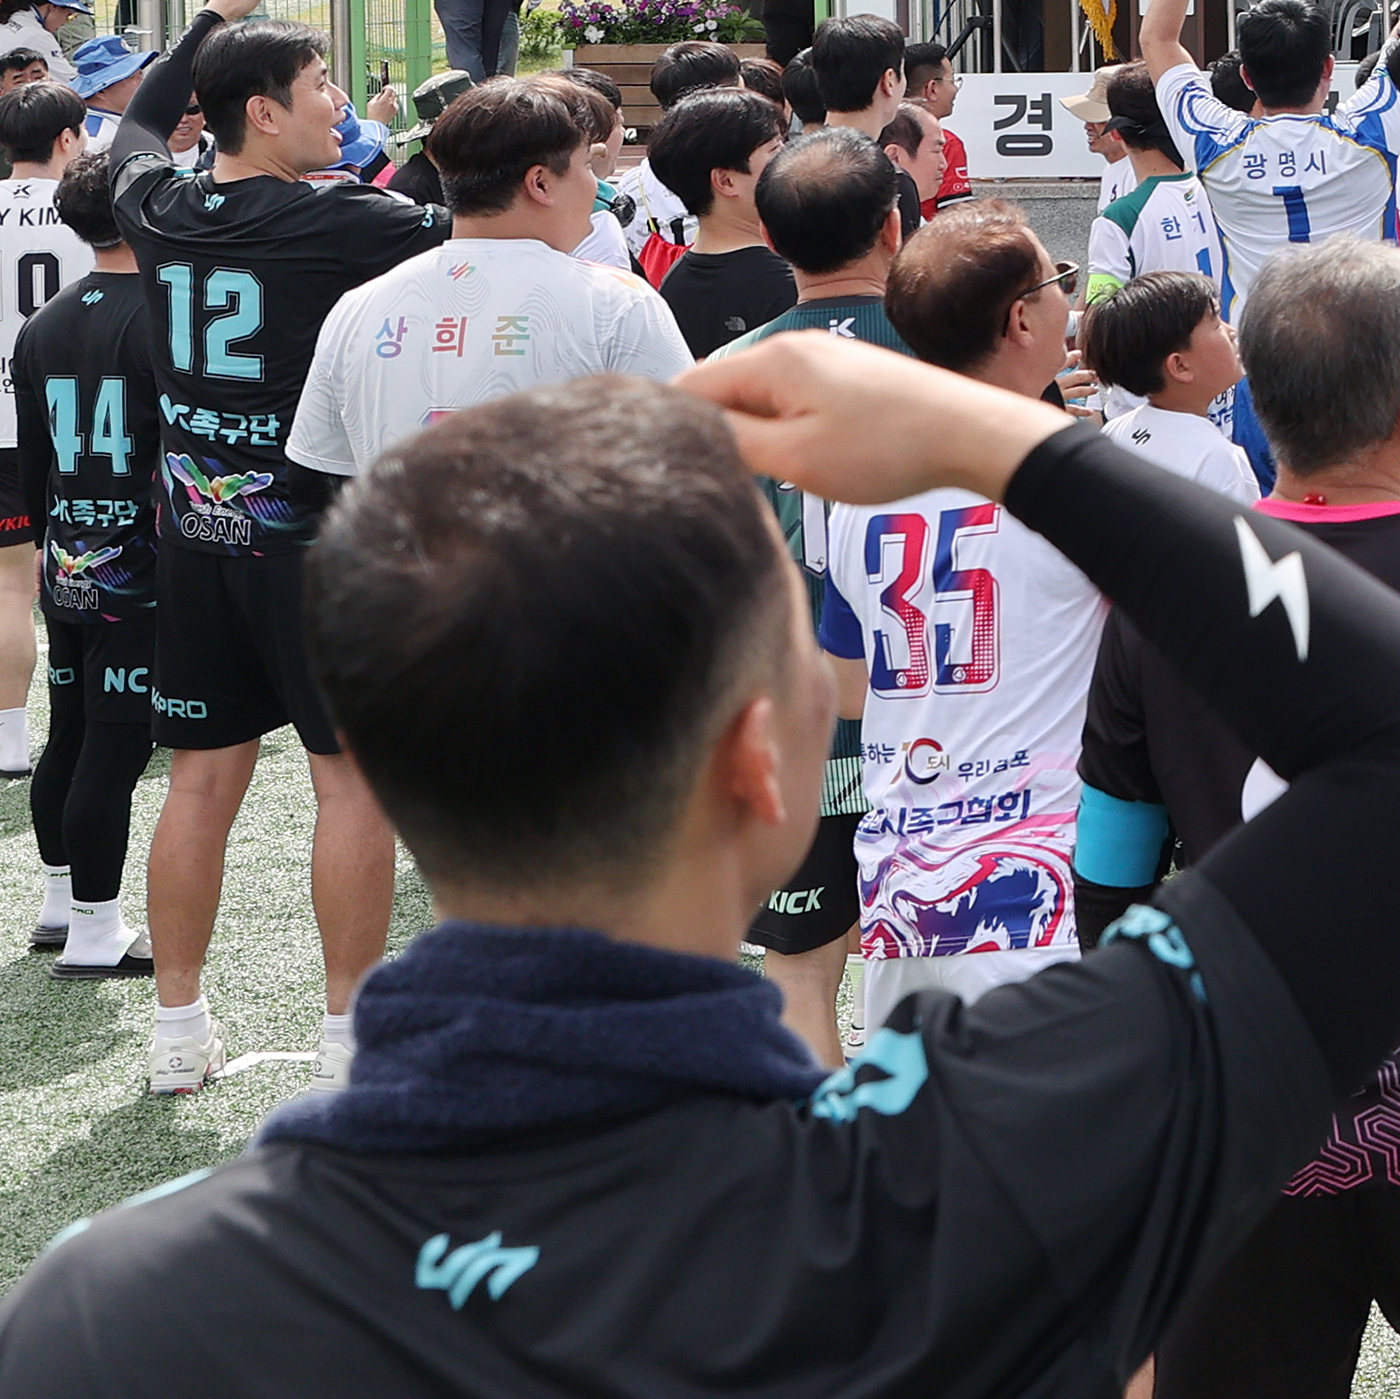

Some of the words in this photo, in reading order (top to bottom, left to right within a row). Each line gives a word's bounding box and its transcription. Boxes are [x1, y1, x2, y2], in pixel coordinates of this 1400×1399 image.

[992, 91, 1054, 157] 경
[155, 260, 265, 383] 12
[45, 375, 136, 477] 44
[180, 511, 252, 546] OSAN
[53, 585, 100, 610] OSAN
[863, 502, 1001, 700] 35
